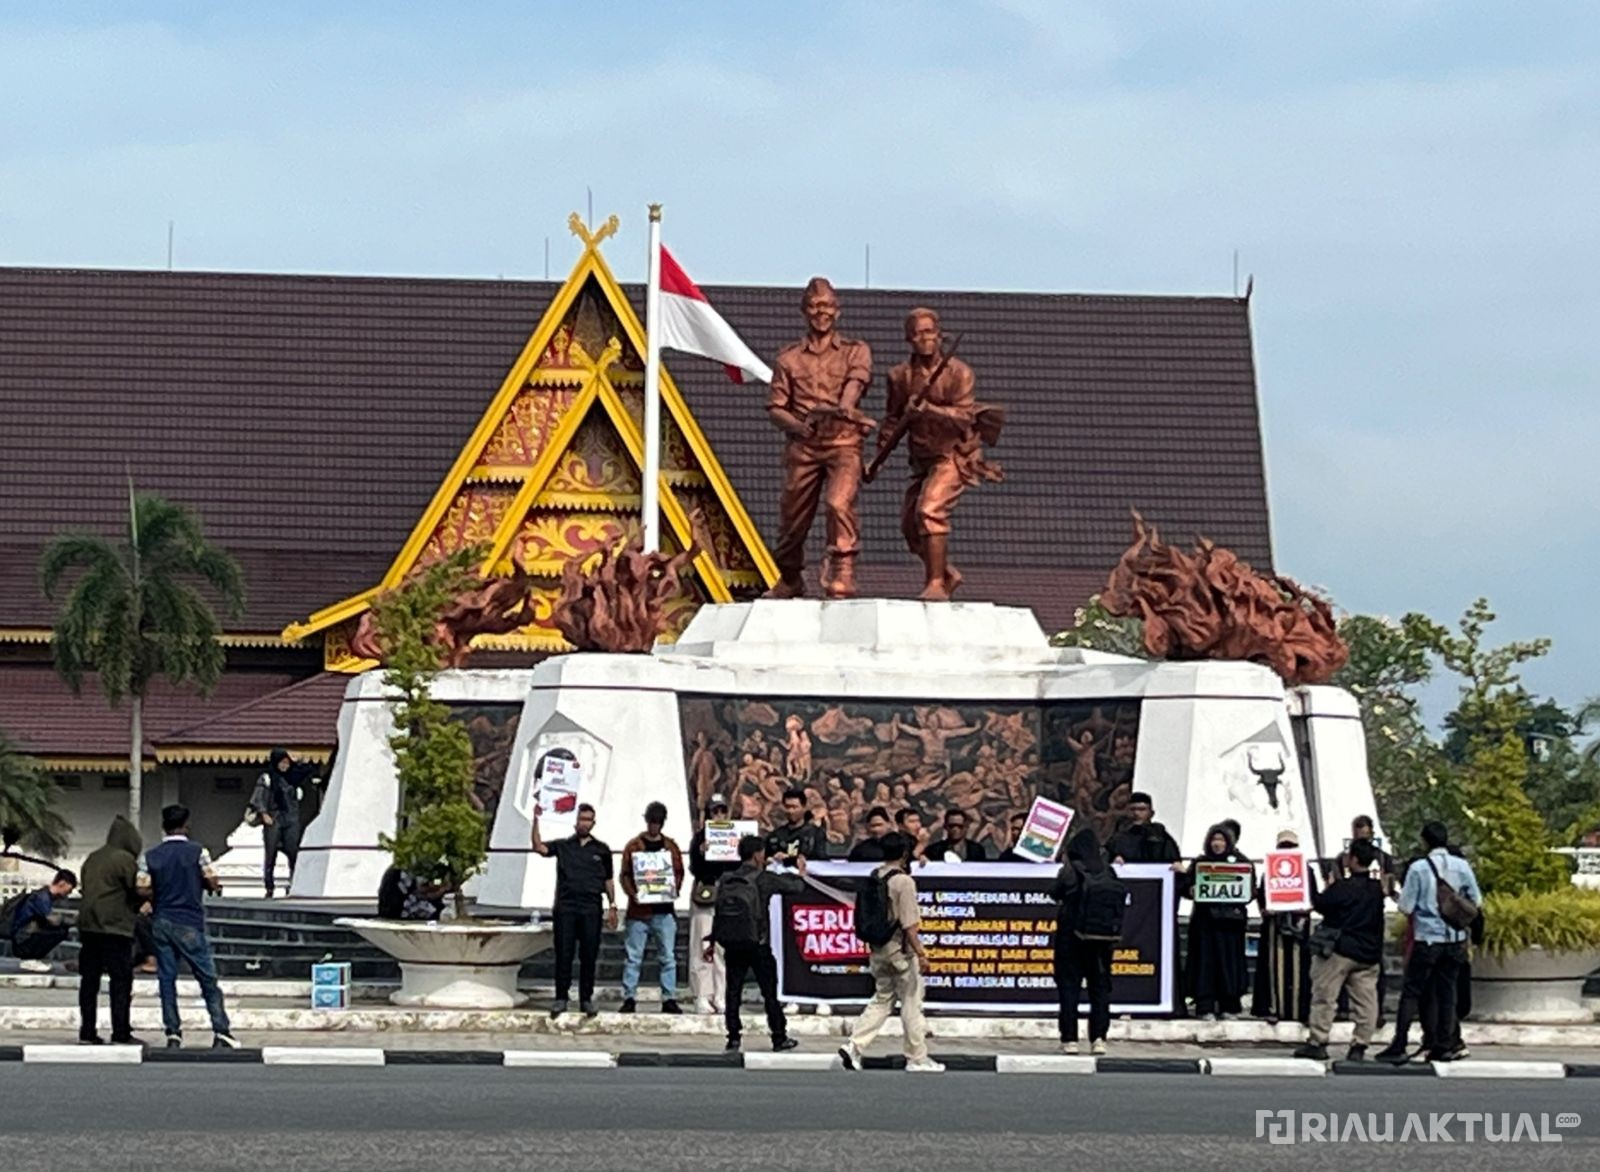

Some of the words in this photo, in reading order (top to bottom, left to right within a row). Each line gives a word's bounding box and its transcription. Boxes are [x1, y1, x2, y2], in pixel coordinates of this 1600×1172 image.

[1270, 877, 1302, 888] STOP
[1199, 884, 1244, 898] RIAU
[794, 909, 855, 931] SERU
